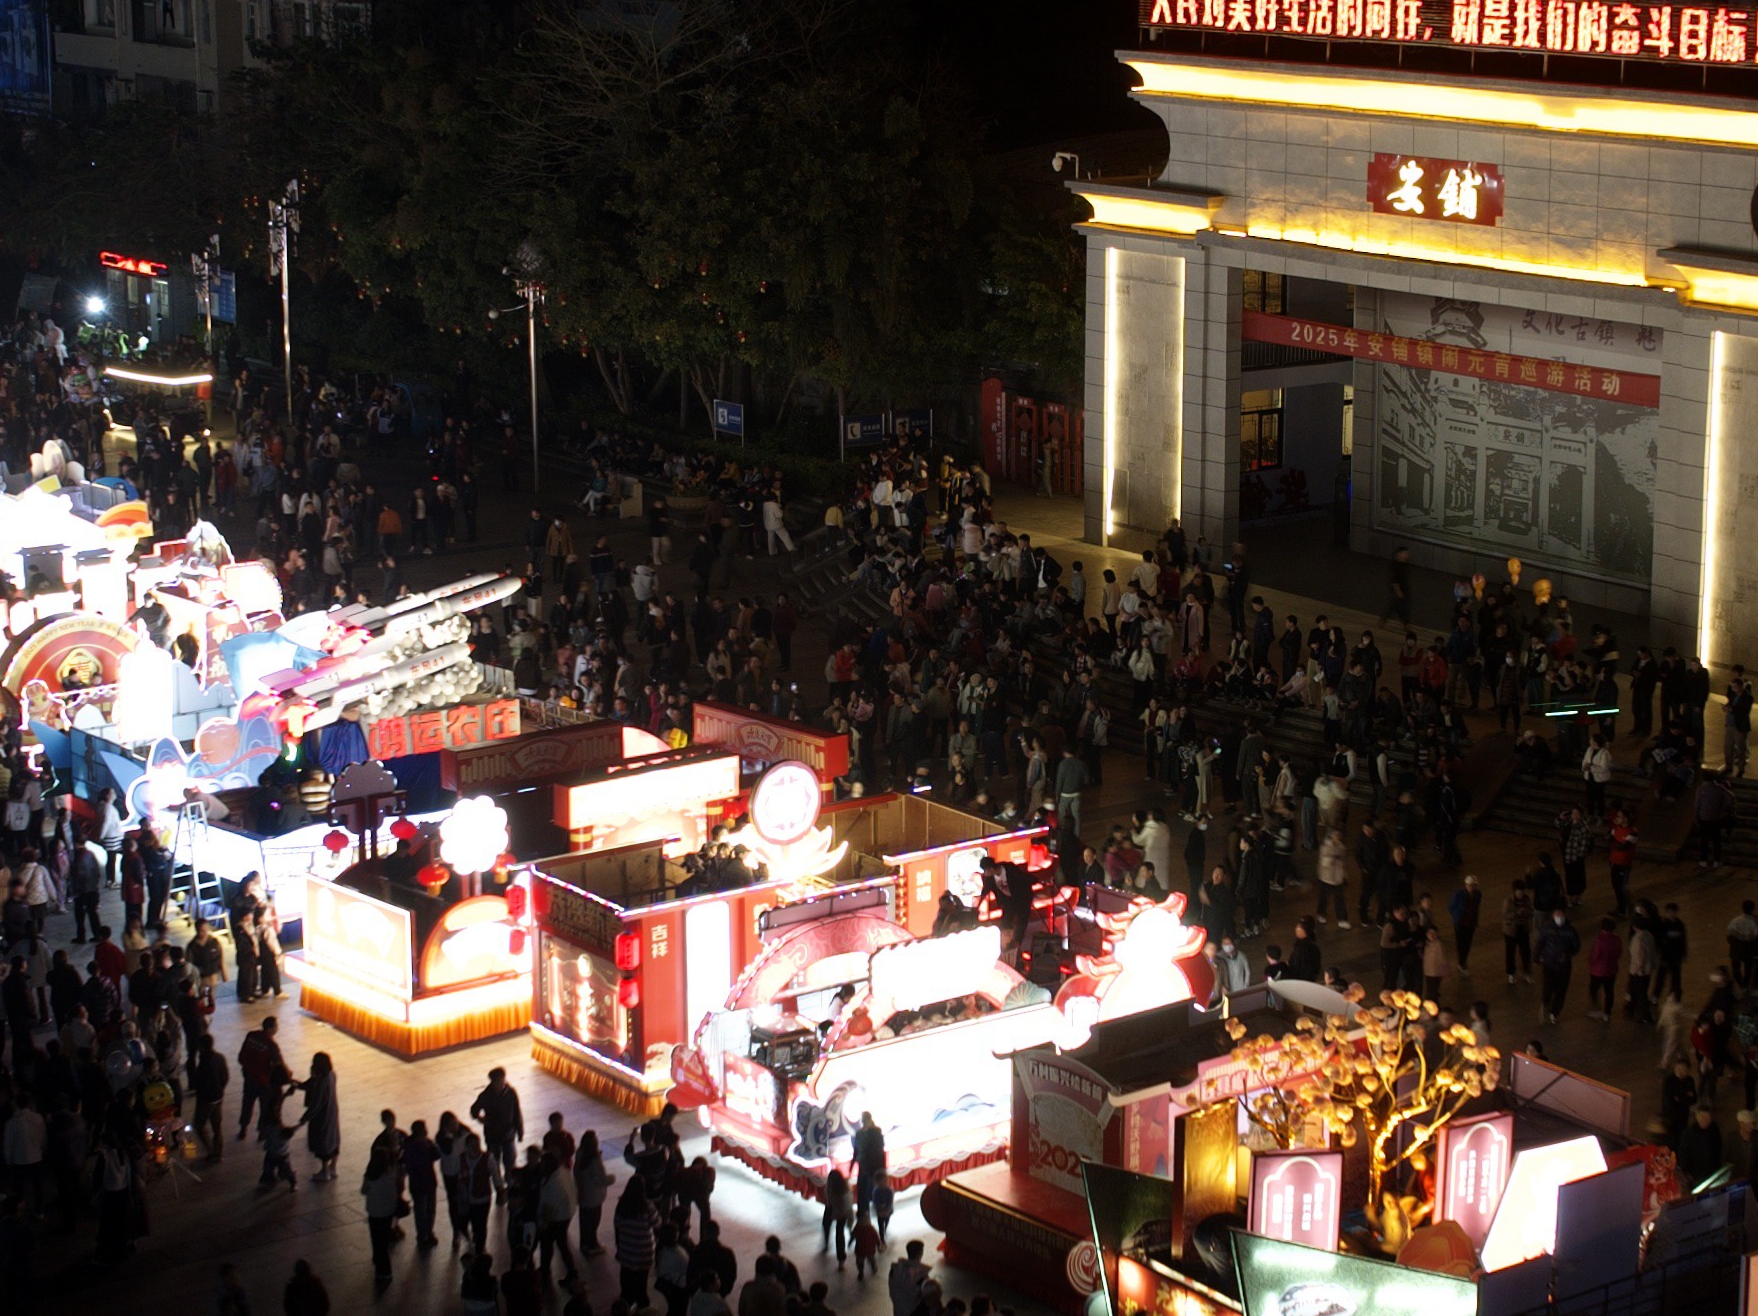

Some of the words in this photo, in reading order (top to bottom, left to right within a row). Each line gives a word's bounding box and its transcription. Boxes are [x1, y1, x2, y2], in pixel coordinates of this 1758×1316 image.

[1290, 321, 1621, 397] 2025年安铺镇闹元宵巡游活动
[368, 698, 521, 761] 鸿运农庄
[651, 924, 668, 959] 吉祥
[1040, 1139, 1083, 1179] 202
